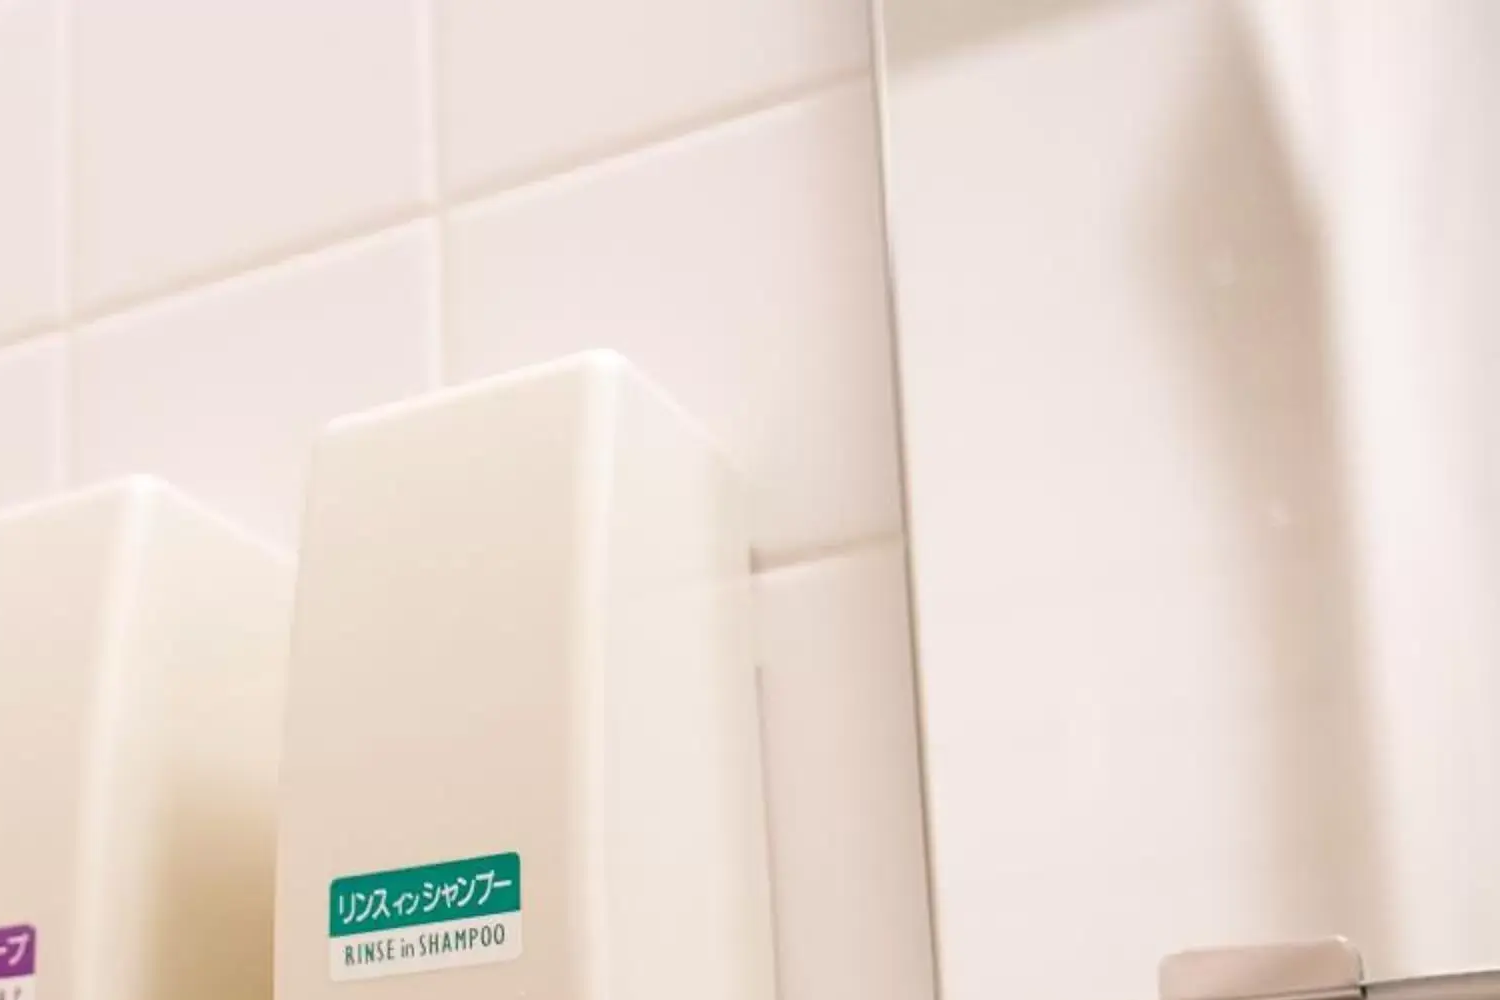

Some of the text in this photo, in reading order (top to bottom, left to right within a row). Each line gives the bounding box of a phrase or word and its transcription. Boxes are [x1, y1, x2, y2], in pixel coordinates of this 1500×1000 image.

[344, 923, 506, 966] RINSE in SHAMPOO
